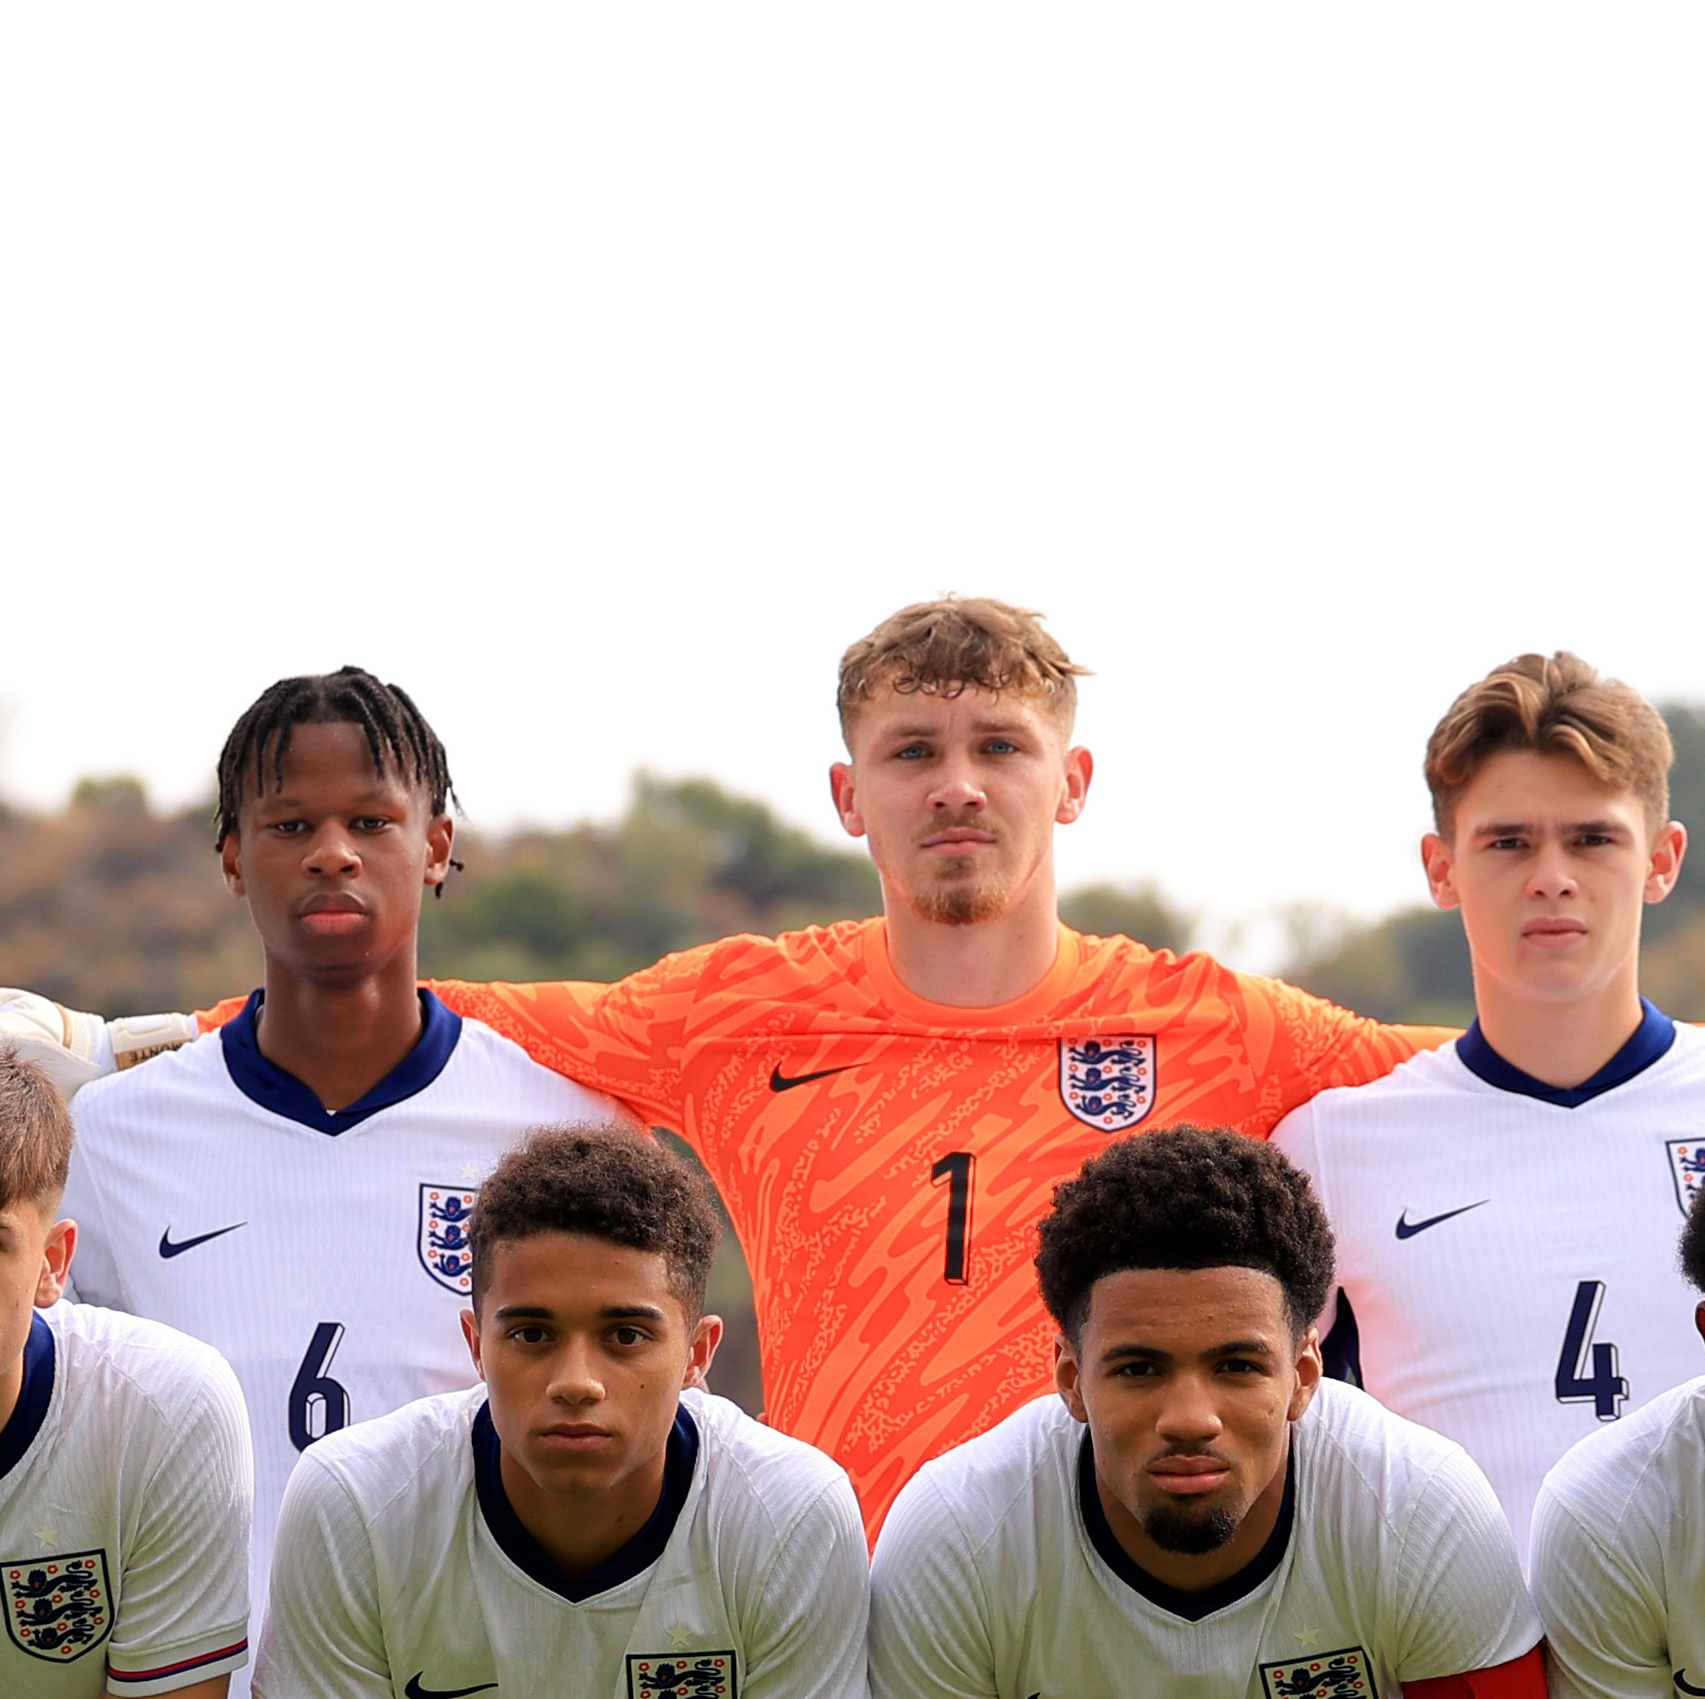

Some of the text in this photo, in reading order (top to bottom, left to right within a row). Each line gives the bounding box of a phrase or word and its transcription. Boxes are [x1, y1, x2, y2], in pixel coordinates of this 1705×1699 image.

[931, 1151, 977, 1286] 1
[288, 1321, 352, 1454] 6
[1554, 1280, 1630, 1422] 4
